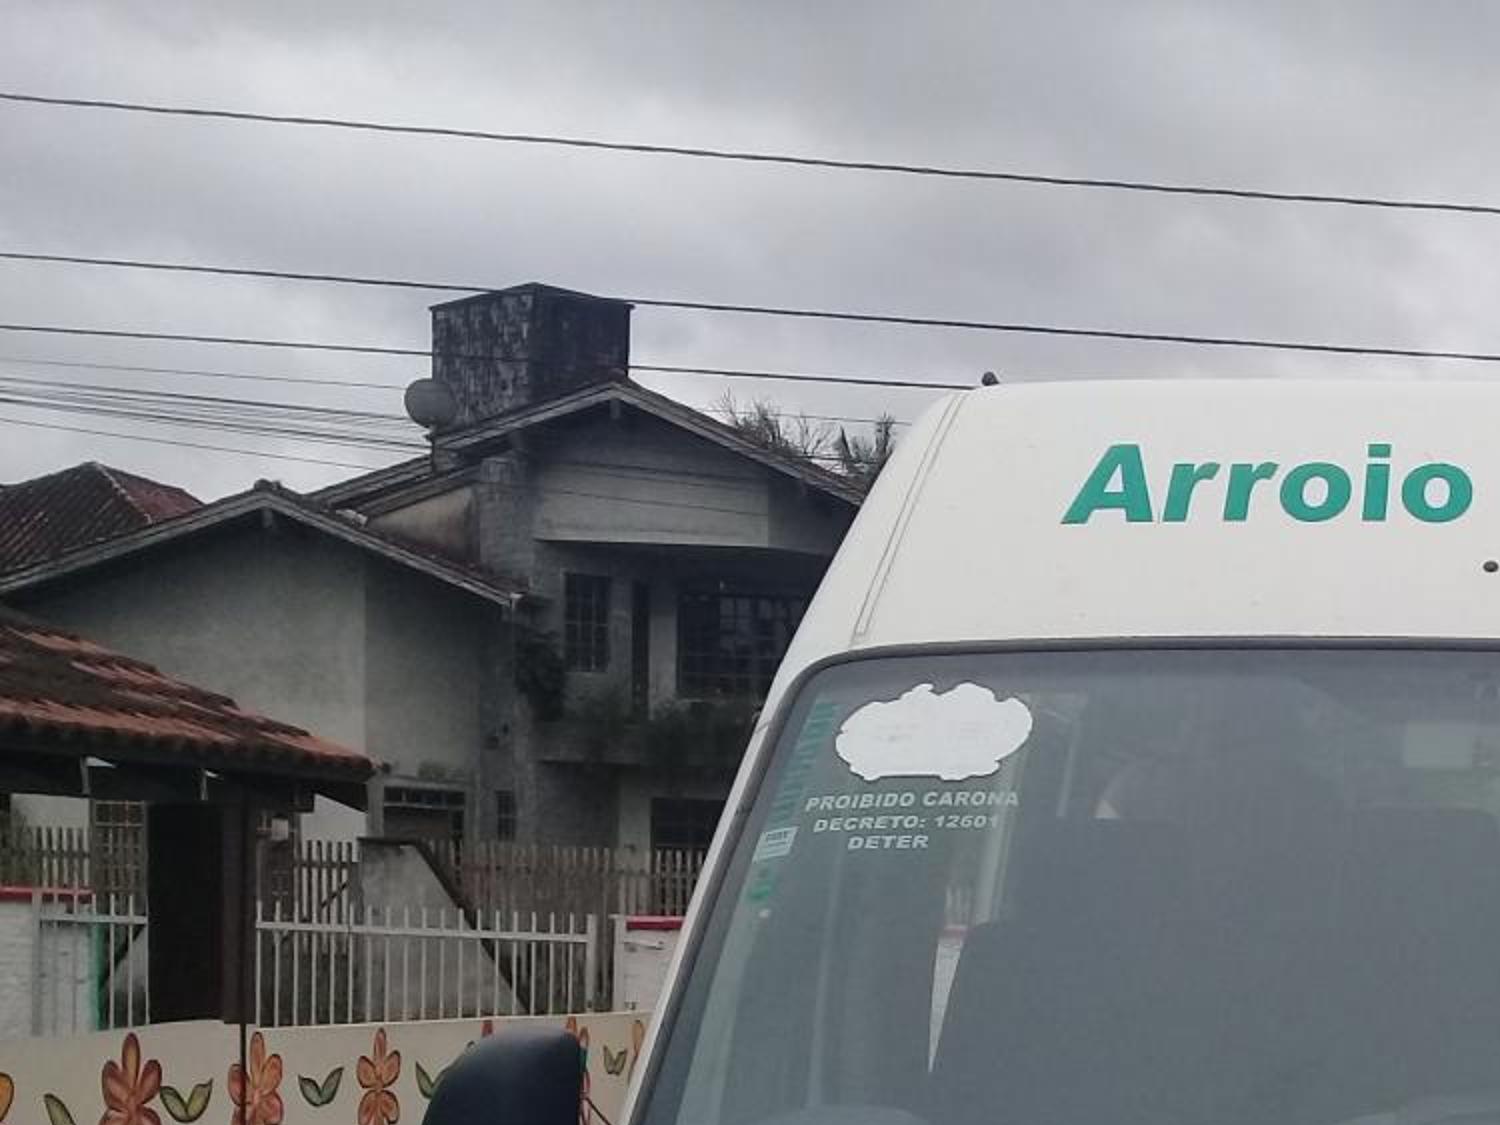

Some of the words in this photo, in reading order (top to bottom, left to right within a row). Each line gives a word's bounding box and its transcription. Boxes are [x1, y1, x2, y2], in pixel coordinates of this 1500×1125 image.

[1064, 442, 1474, 525] Arroio
[805, 792, 915, 812] PROIBIDO
[922, 791, 1020, 807] CARONA
[813, 815, 926, 832] DECRETO:
[848, 834, 929, 850] DETER
